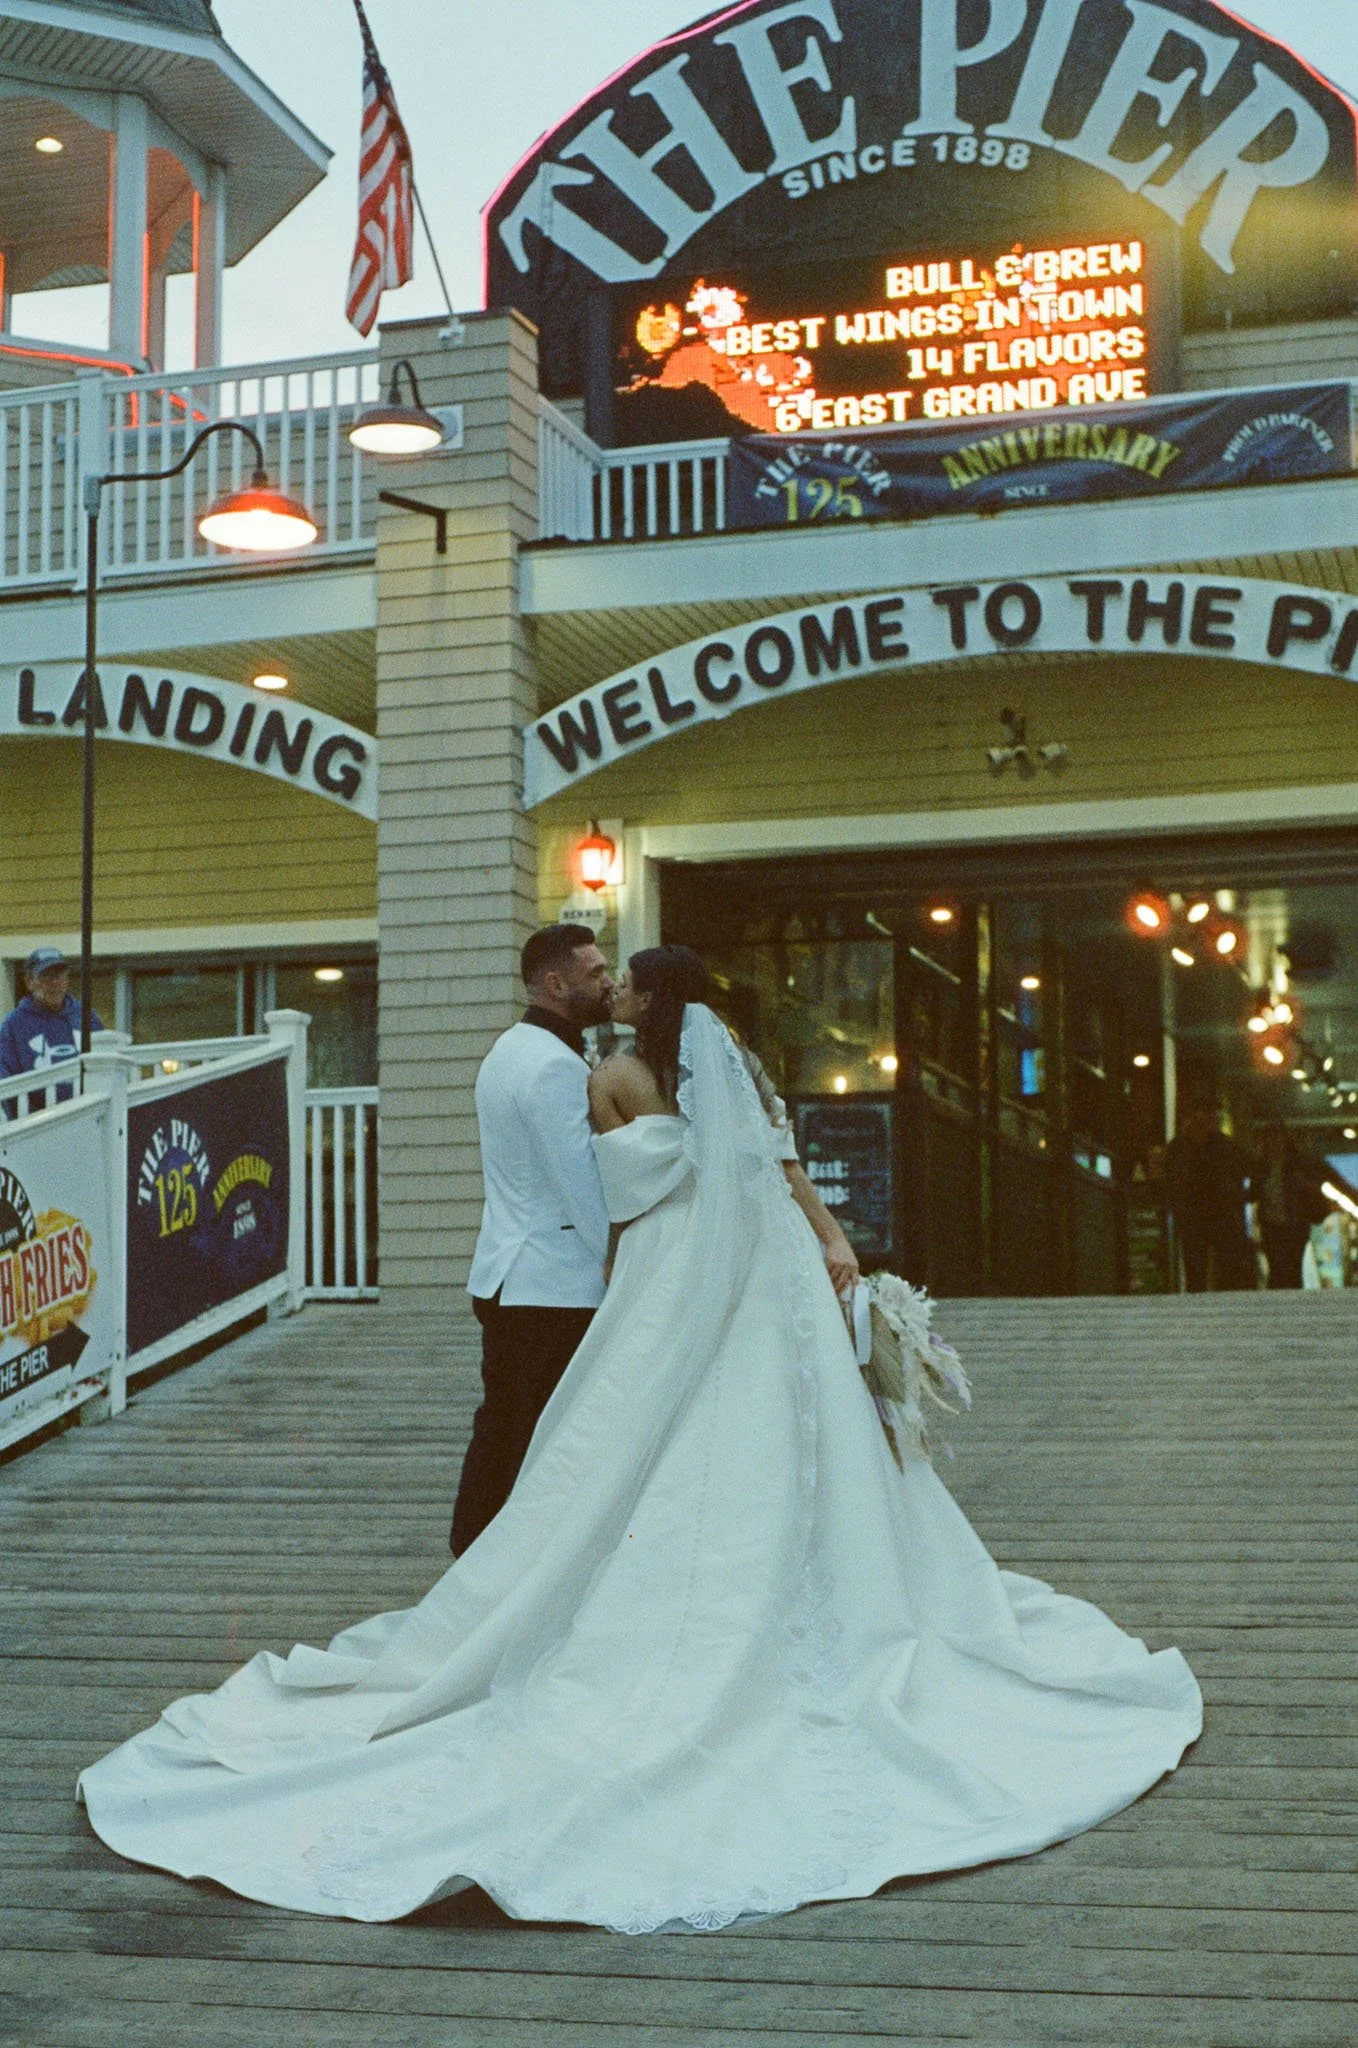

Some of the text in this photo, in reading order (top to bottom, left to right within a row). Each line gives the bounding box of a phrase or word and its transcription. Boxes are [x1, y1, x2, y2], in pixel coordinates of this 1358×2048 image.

[500, 0, 1330, 283] THE PIER
[782, 135, 1031, 199] SINCE 1898
[886, 259, 984, 299] BULL
[1033, 241, 1142, 283] BREW
[727, 283, 1143, 356] BEST WINGS IN TOWN
[907, 326, 1145, 379] 14 FLAVORS
[776, 367, 1147, 432] 6 EAST GRAND AVE
[755, 442, 892, 499] THE PIER
[941, 423, 1182, 490] ANNIVERSARY
[781, 477, 863, 521] 125
[538, 579, 1358, 774] WELCOME TO THE PI
[18, 668, 367, 800] LANDING
[138, 1119, 210, 1206] THE PIER
[156, 1163, 196, 1238] 125
[21, 1225, 88, 1316] FRIES
[0, 1345, 49, 1393] HE PIER
